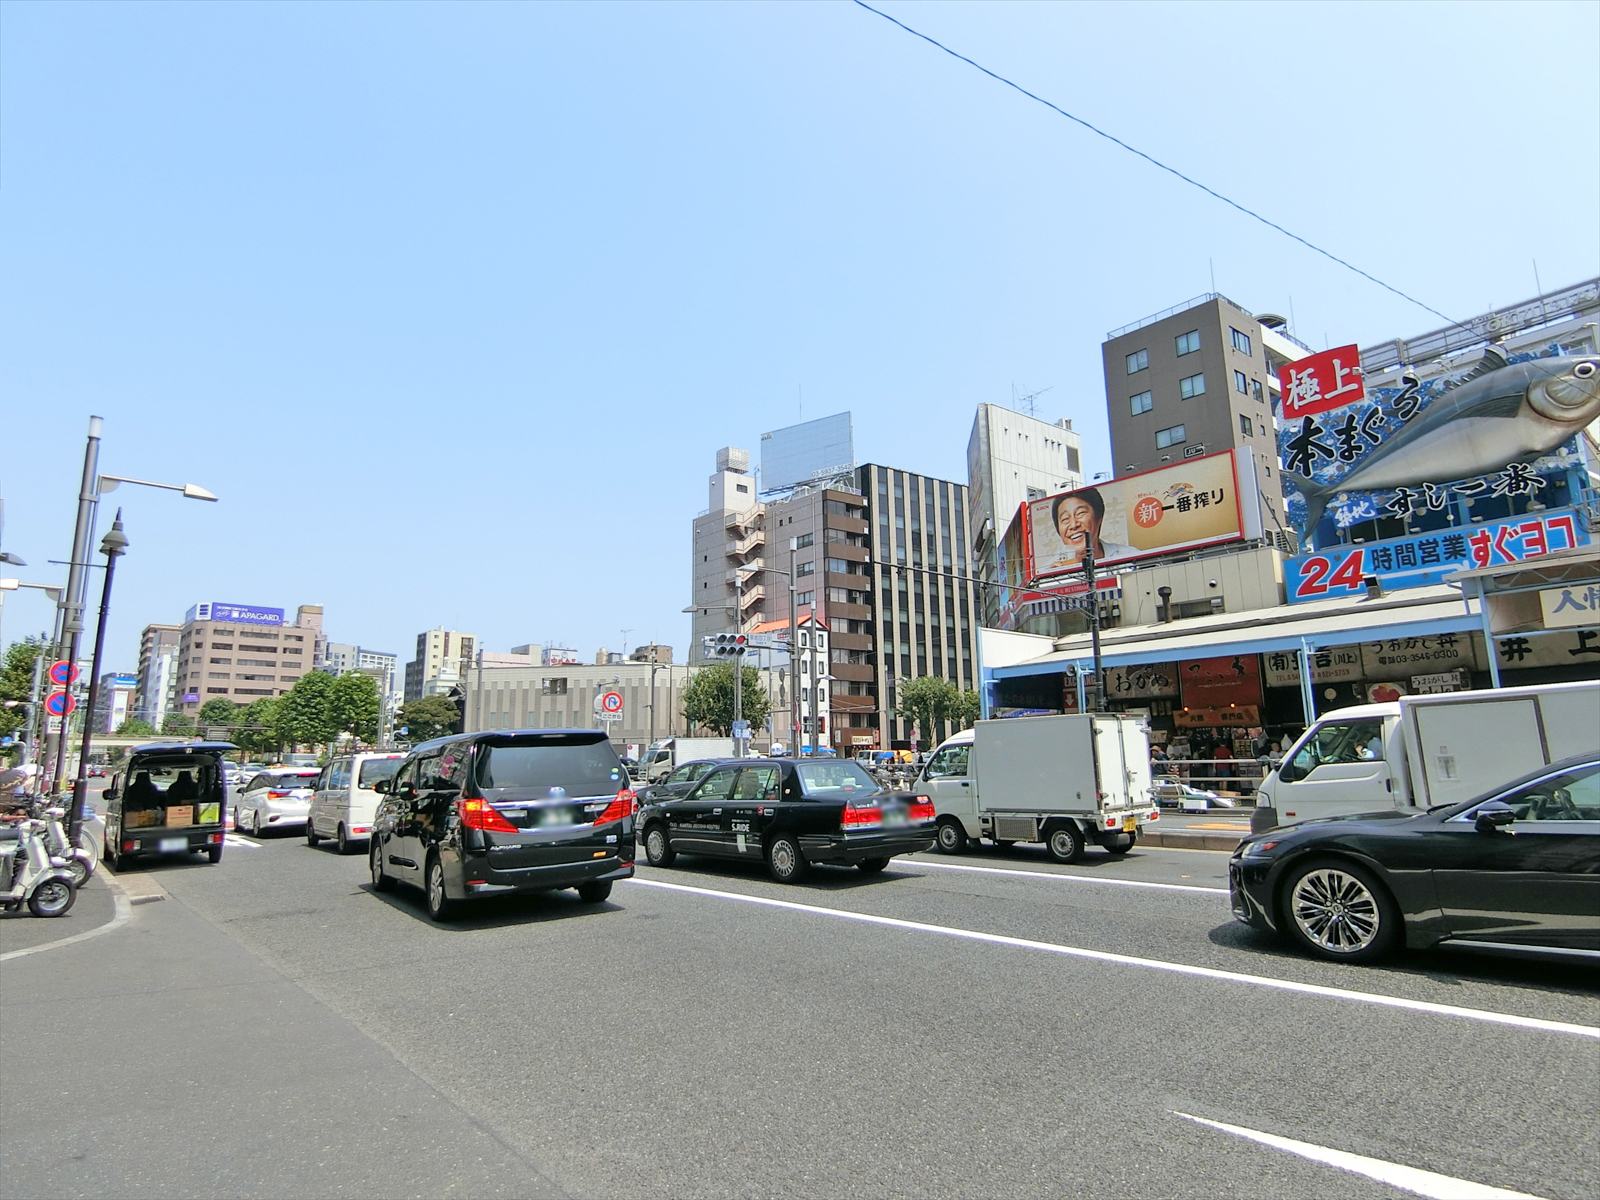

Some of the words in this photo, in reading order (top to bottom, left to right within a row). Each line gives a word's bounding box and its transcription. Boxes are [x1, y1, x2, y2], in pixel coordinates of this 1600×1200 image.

[1286, 359, 1358, 410] 極上
[1285, 375, 1421, 478] 本まぐろ
[811, 463, 852, 477] 03-5937-3542
[1161, 488, 1224, 513] 一番搾り
[1385, 462, 1547, 519] すし一番
[1334, 501, 1376, 528] 築地
[1552, 586, 1600, 614] 人
[240, 611, 279, 621] APAGARD
